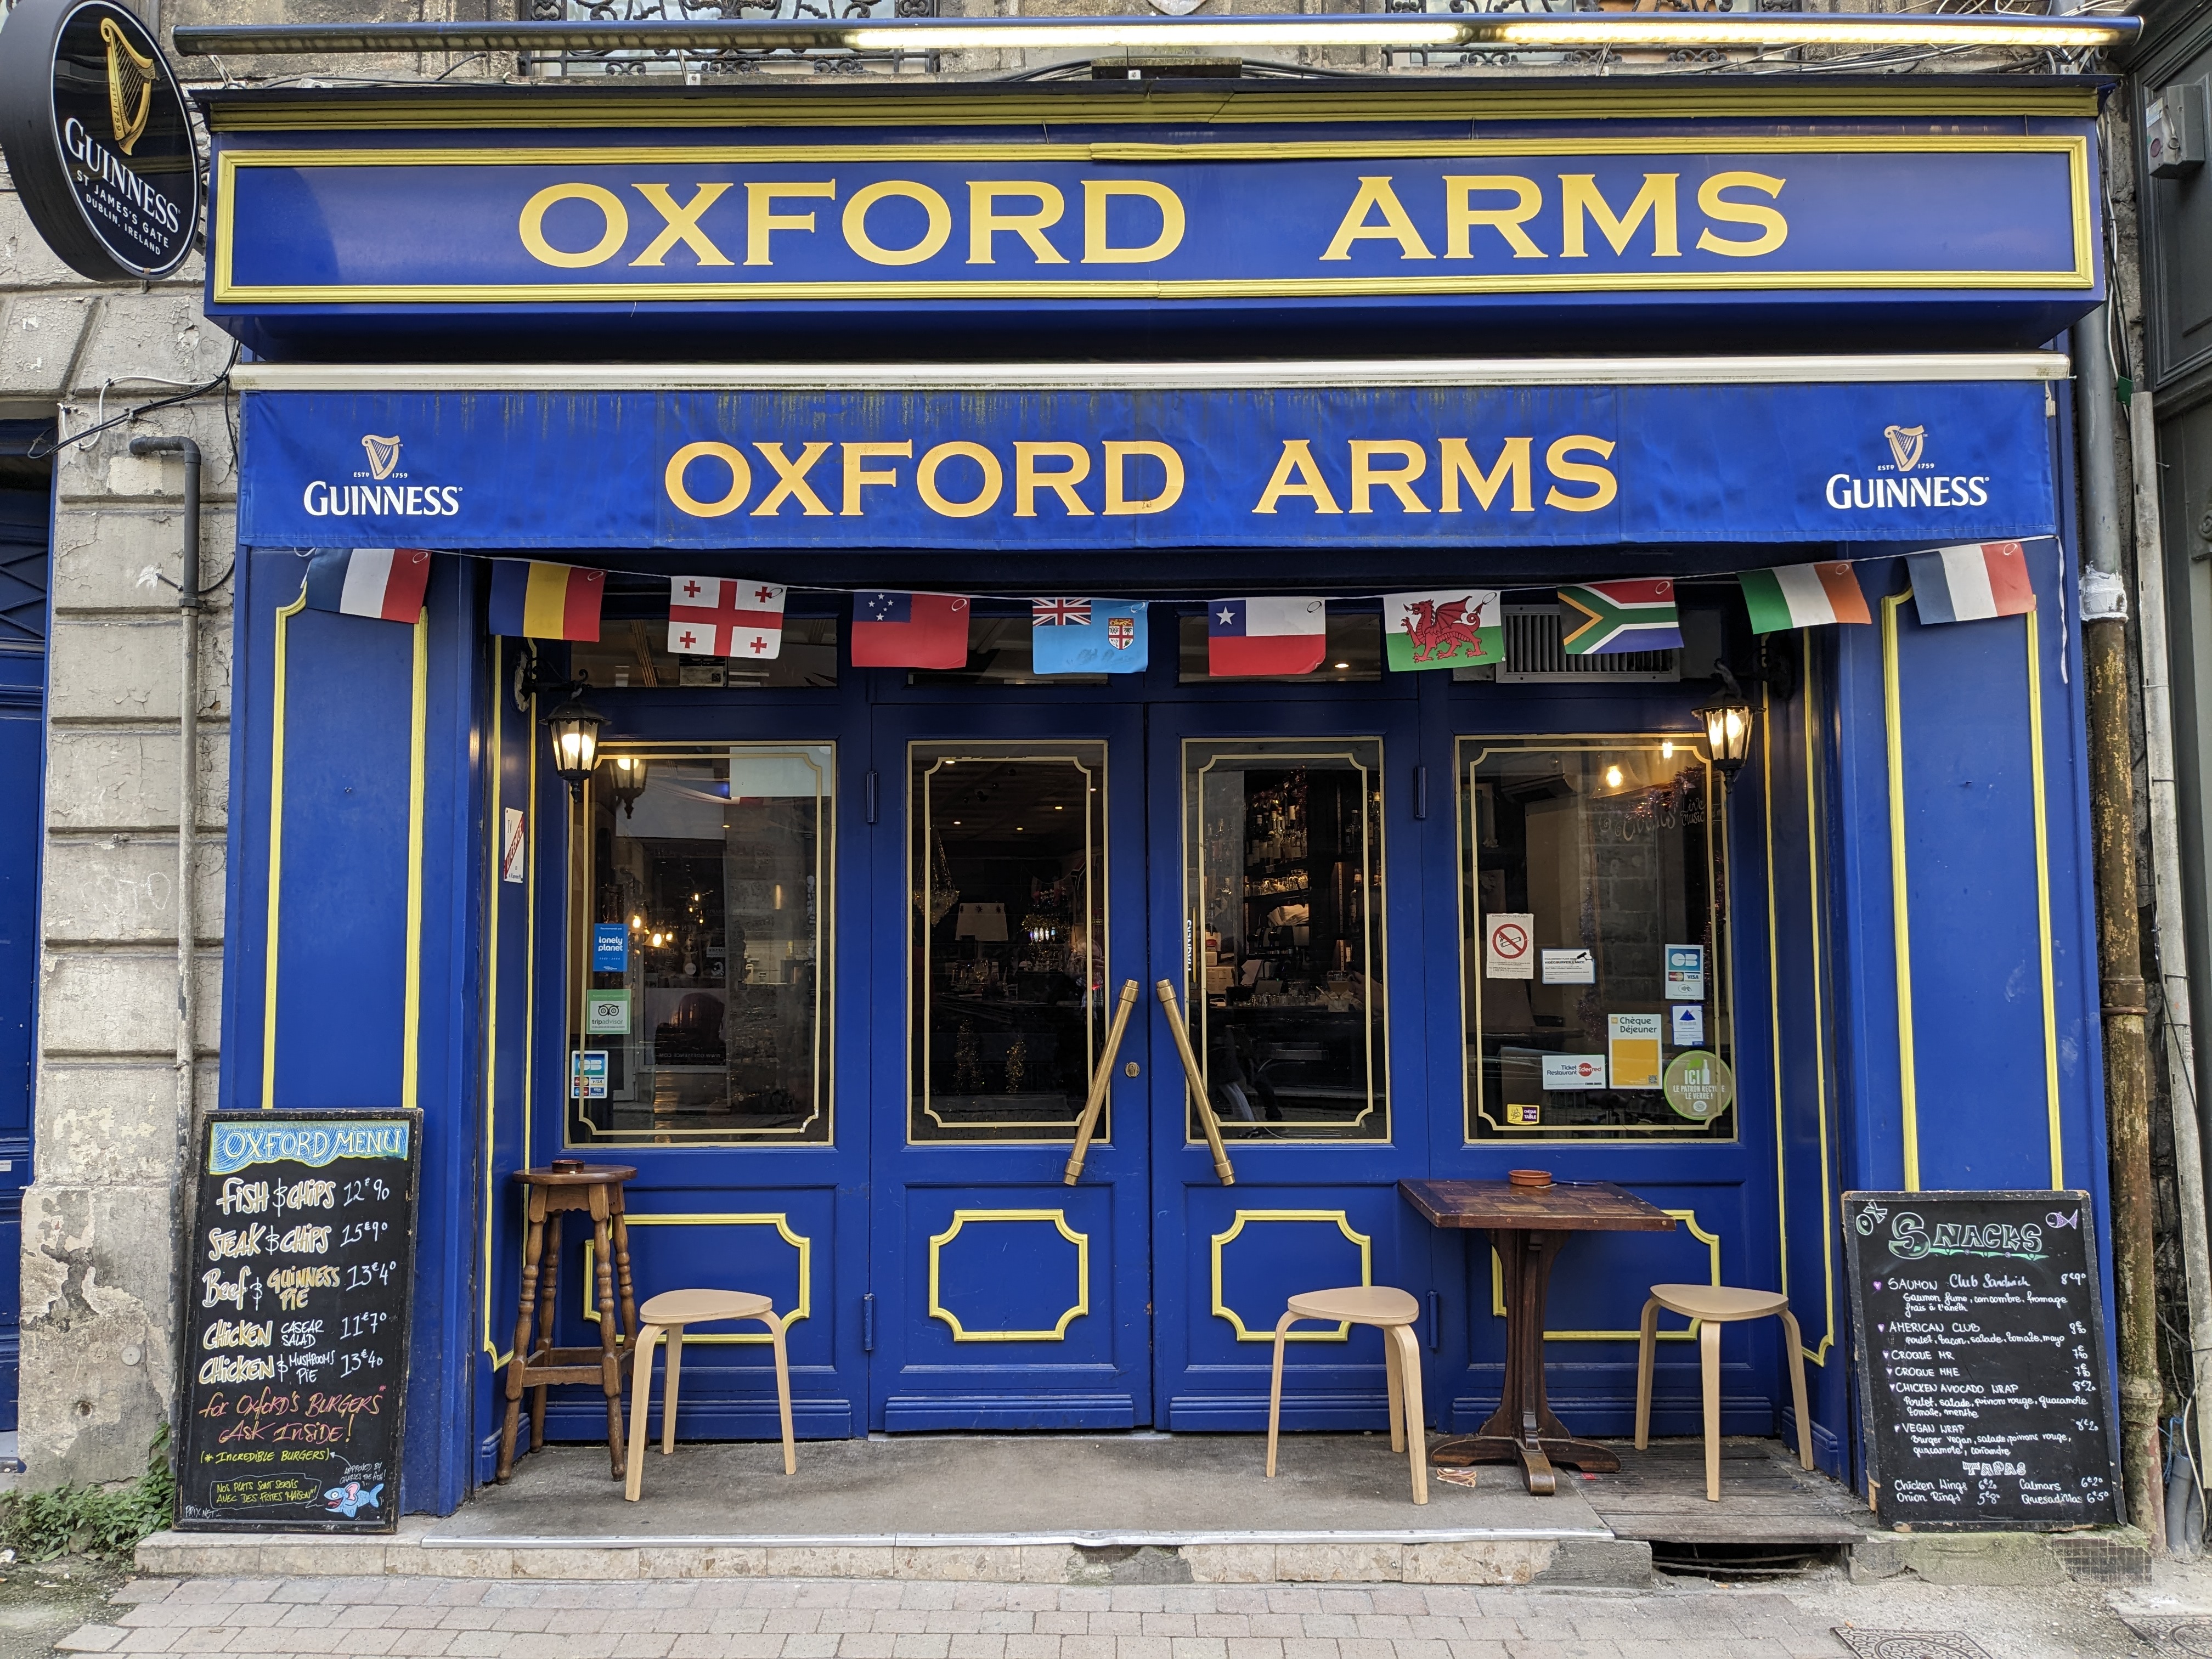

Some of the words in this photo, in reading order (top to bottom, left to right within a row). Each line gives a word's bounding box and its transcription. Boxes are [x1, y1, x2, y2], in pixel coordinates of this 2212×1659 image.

[113, 105, 121, 131] 1759
[65, 117, 179, 233] GUINNESS
[77, 170, 89, 187] ST
[94, 184, 138, 225] JAMES'S
[143, 222, 169, 248] GATE
[518, 179, 1186, 268] OXFORD
[1319, 171, 1788, 261] ARMS
[125, 223, 161, 255] IRELAND
[663, 439, 1186, 520] OXFORD
[1250, 434, 1618, 516] ARMS
[303, 481, 459, 516] GUINNESS
[1826, 473, 1988, 509] GUINNESS
[599, 936, 623, 945] lonely
[1620, 1017, 1651, 1027] Chèque
[1620, 1025, 1657, 1034] Déjeuner
[1684, 1069, 1700, 1085] ICI
[224, 1132, 329, 1159] OXFORD
[330, 1130, 401, 1154] MENU
[202, 1266, 252, 1311] Beef
[1888, 1278, 1938, 1290] SAUMON
[1949, 1273, 1978, 1288] Club
[1983, 1273, 2031, 1288] Sandwich
[2027, 1291, 2068, 1308] fromage
[1889, 1321, 1945, 1333] AMERICAN
[1951, 1322, 1980, 1333] CLUB
[280, 1333, 317, 1348] SALAD
[289, 1350, 336, 1368] MUSHROOMS
[1891, 1350, 1933, 1361] CROQUE
[1938, 1351, 1955, 1360] MR
[1895, 1367, 1936, 1377] CROQUE
[1895, 1382, 1938, 1393] CHICKEN
[1940, 1384, 1984, 1393] AVOCADO
[1901, 1423, 1936, 1433] VEGAN
[1962, 1461, 2027, 1476] TAPAS
[217, 1483, 230, 1493] NOS
[234, 1482, 253, 1492] PLATS
[1894, 1479, 1936, 1491] Chicken
[1939, 1479, 1968, 1494] Wings
[2019, 1479, 2062, 1491] Calmars
[216, 1494, 237, 1503] AVEC
[240, 1493, 257, 1503] DES
[1896, 1492, 1928, 1503] Onion
[1930, 1491, 1961, 1505] Rings
[2021, 1493, 2084, 1505] Quesadillas
